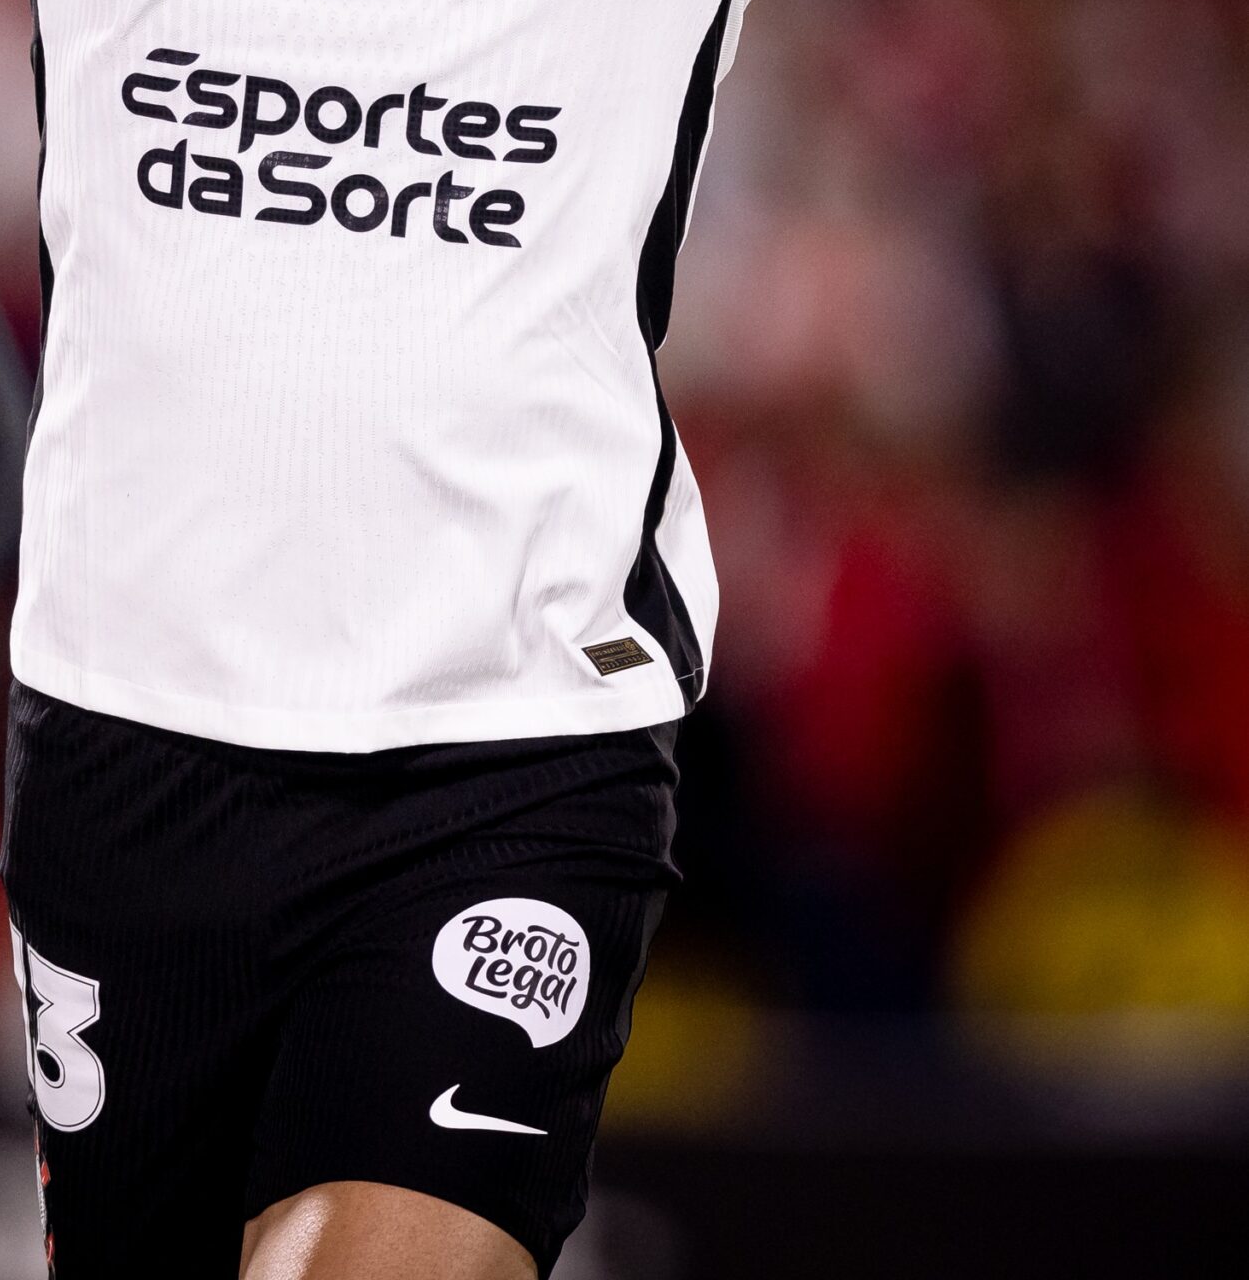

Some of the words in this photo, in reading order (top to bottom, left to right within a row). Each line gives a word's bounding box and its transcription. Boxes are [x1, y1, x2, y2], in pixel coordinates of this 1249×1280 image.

[121, 47, 562, 164] Esportes
[462, 915, 580, 975] Broto
[465, 955, 577, 1020] Legal
